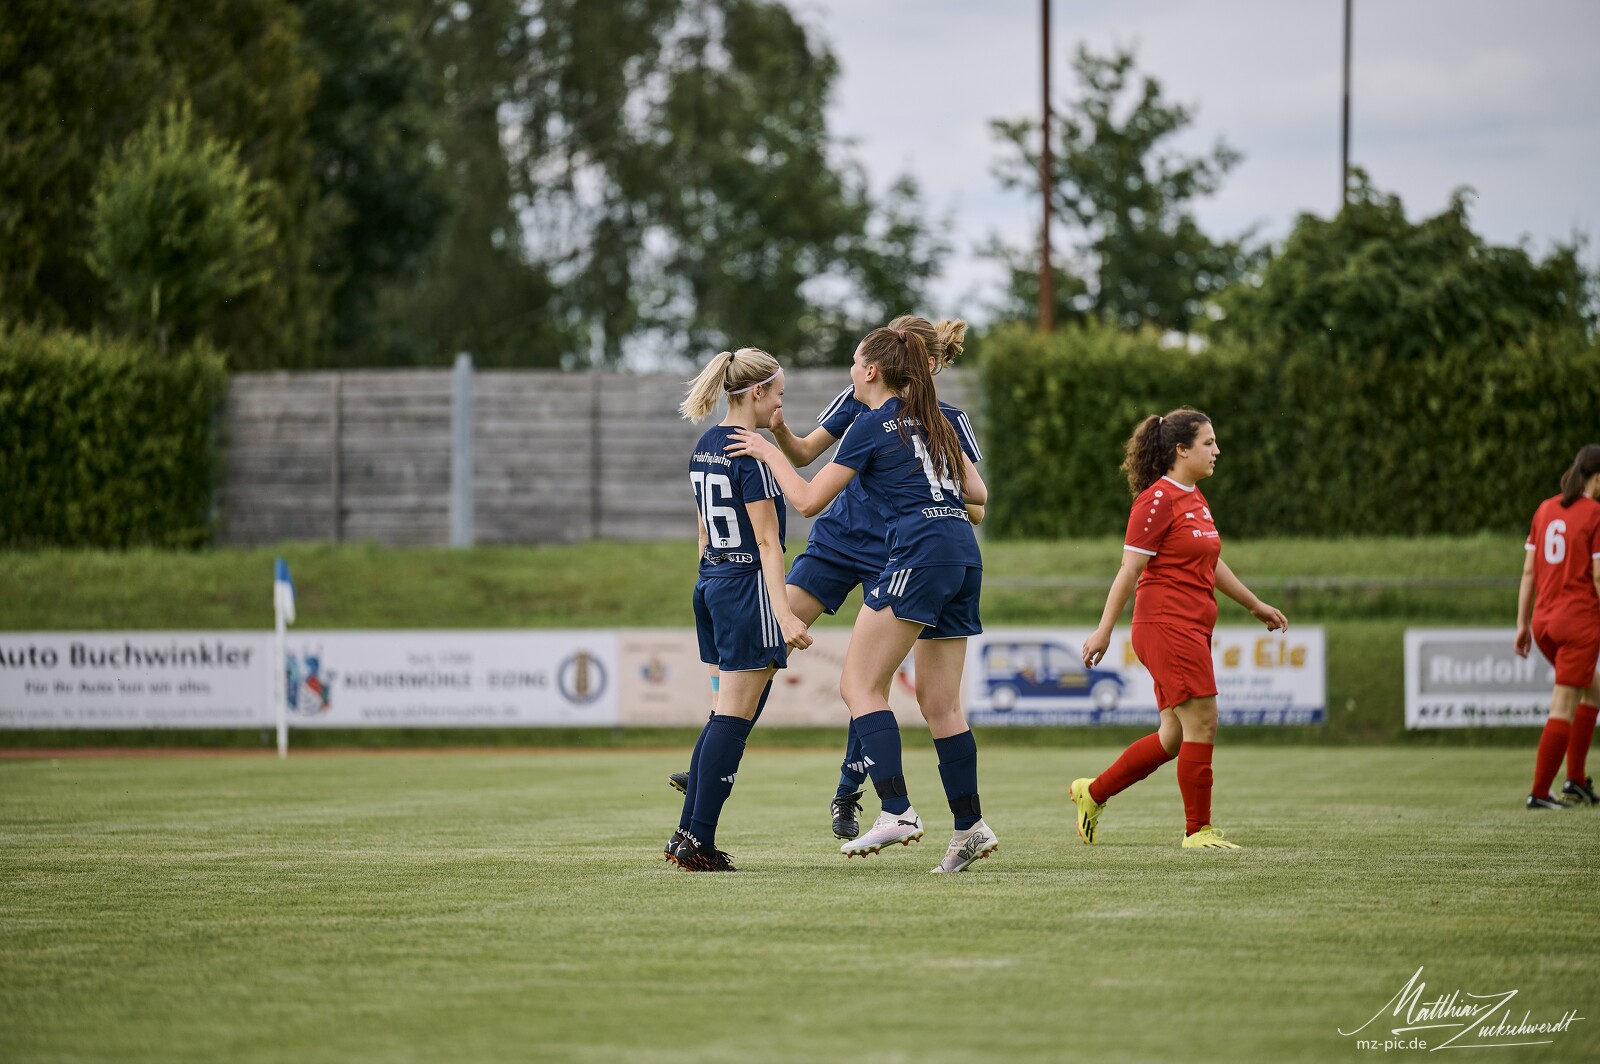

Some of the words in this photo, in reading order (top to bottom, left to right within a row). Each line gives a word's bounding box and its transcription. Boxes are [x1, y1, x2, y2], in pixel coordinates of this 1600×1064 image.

[882, 419, 898, 433] SG
[1544, 518, 1567, 565] 6
[69, 641, 254, 670] Buchwinkler
[1430, 654, 1536, 684] Rudolf
[79, 679, 115, 696] Auto
